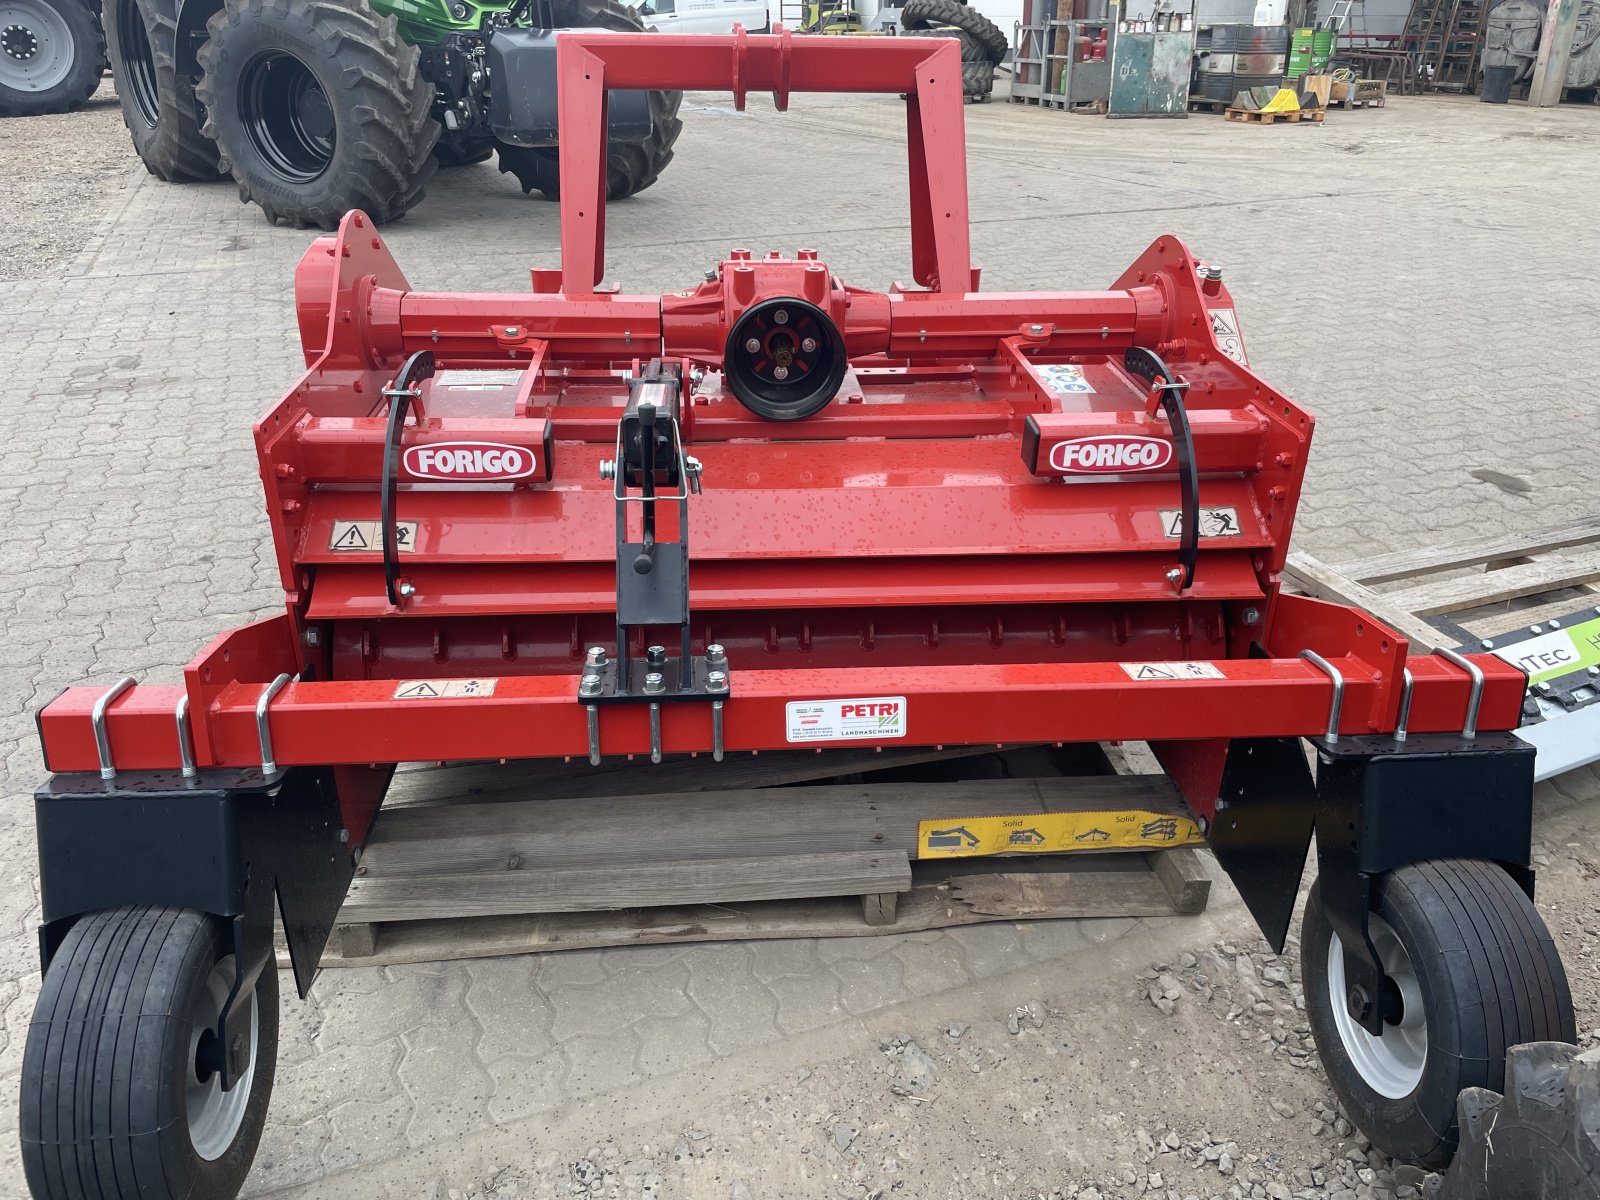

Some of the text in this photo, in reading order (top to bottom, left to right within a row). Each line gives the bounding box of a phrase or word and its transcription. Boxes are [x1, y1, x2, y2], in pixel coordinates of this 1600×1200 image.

[418, 450, 522, 473] FORIGO
[1063, 443, 1160, 467] FORIGO
[841, 703, 898, 718] PETRI
[841, 728, 899, 736] LANDMASCHINEN
[1115, 815, 1136, 823] Solid
